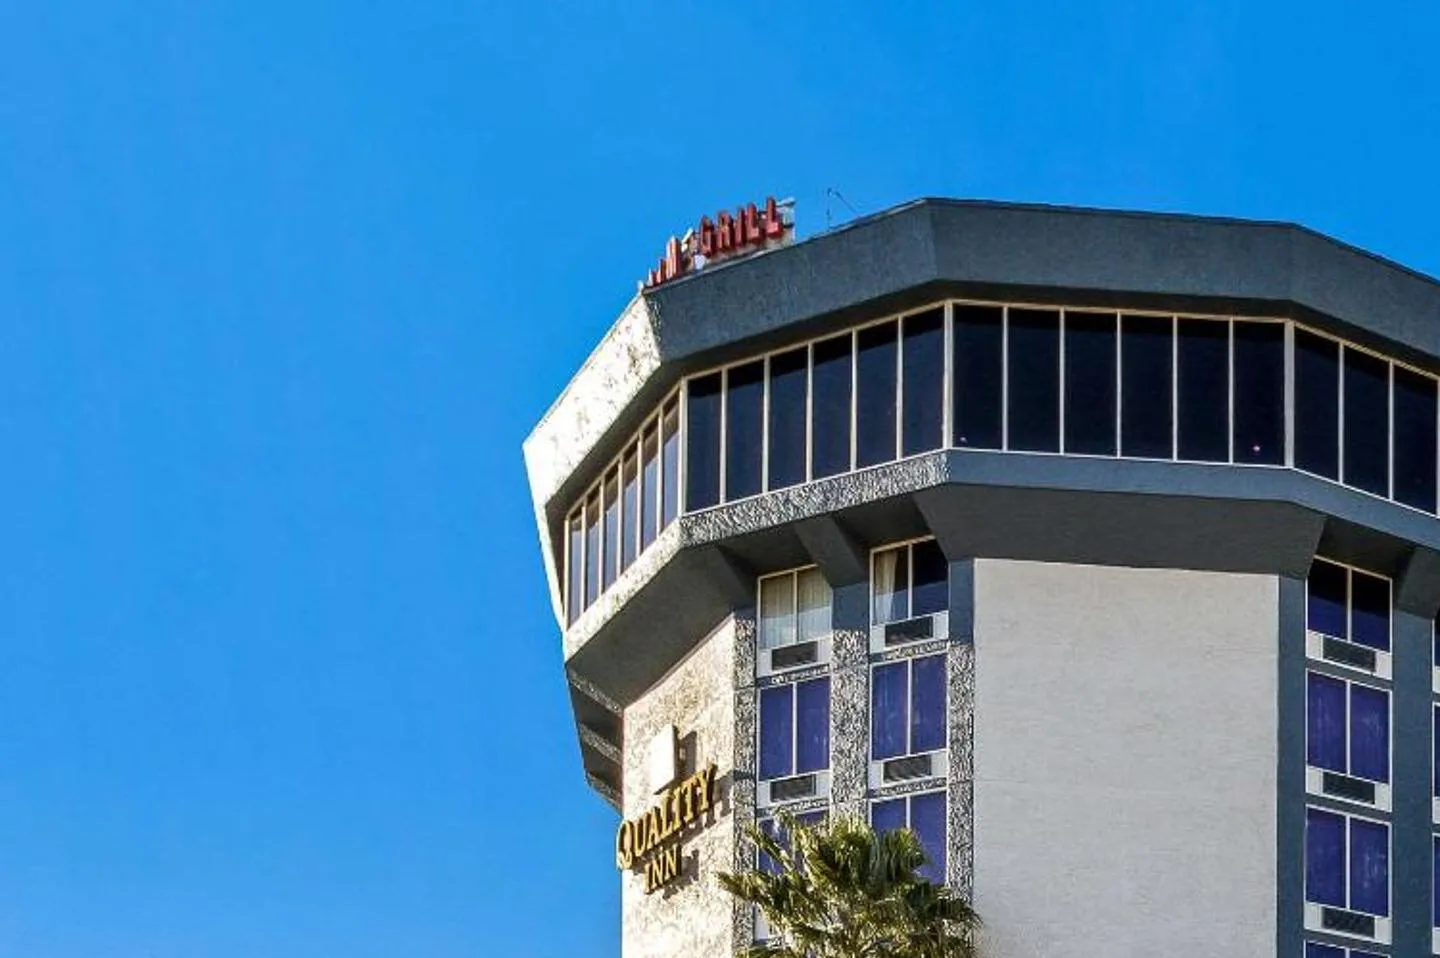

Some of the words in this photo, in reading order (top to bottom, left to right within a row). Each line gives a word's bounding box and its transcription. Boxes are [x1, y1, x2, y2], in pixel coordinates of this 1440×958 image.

[700, 196, 782, 258] GRILL
[617, 762, 718, 870] QUALITY
[644, 844, 682, 895] INN
